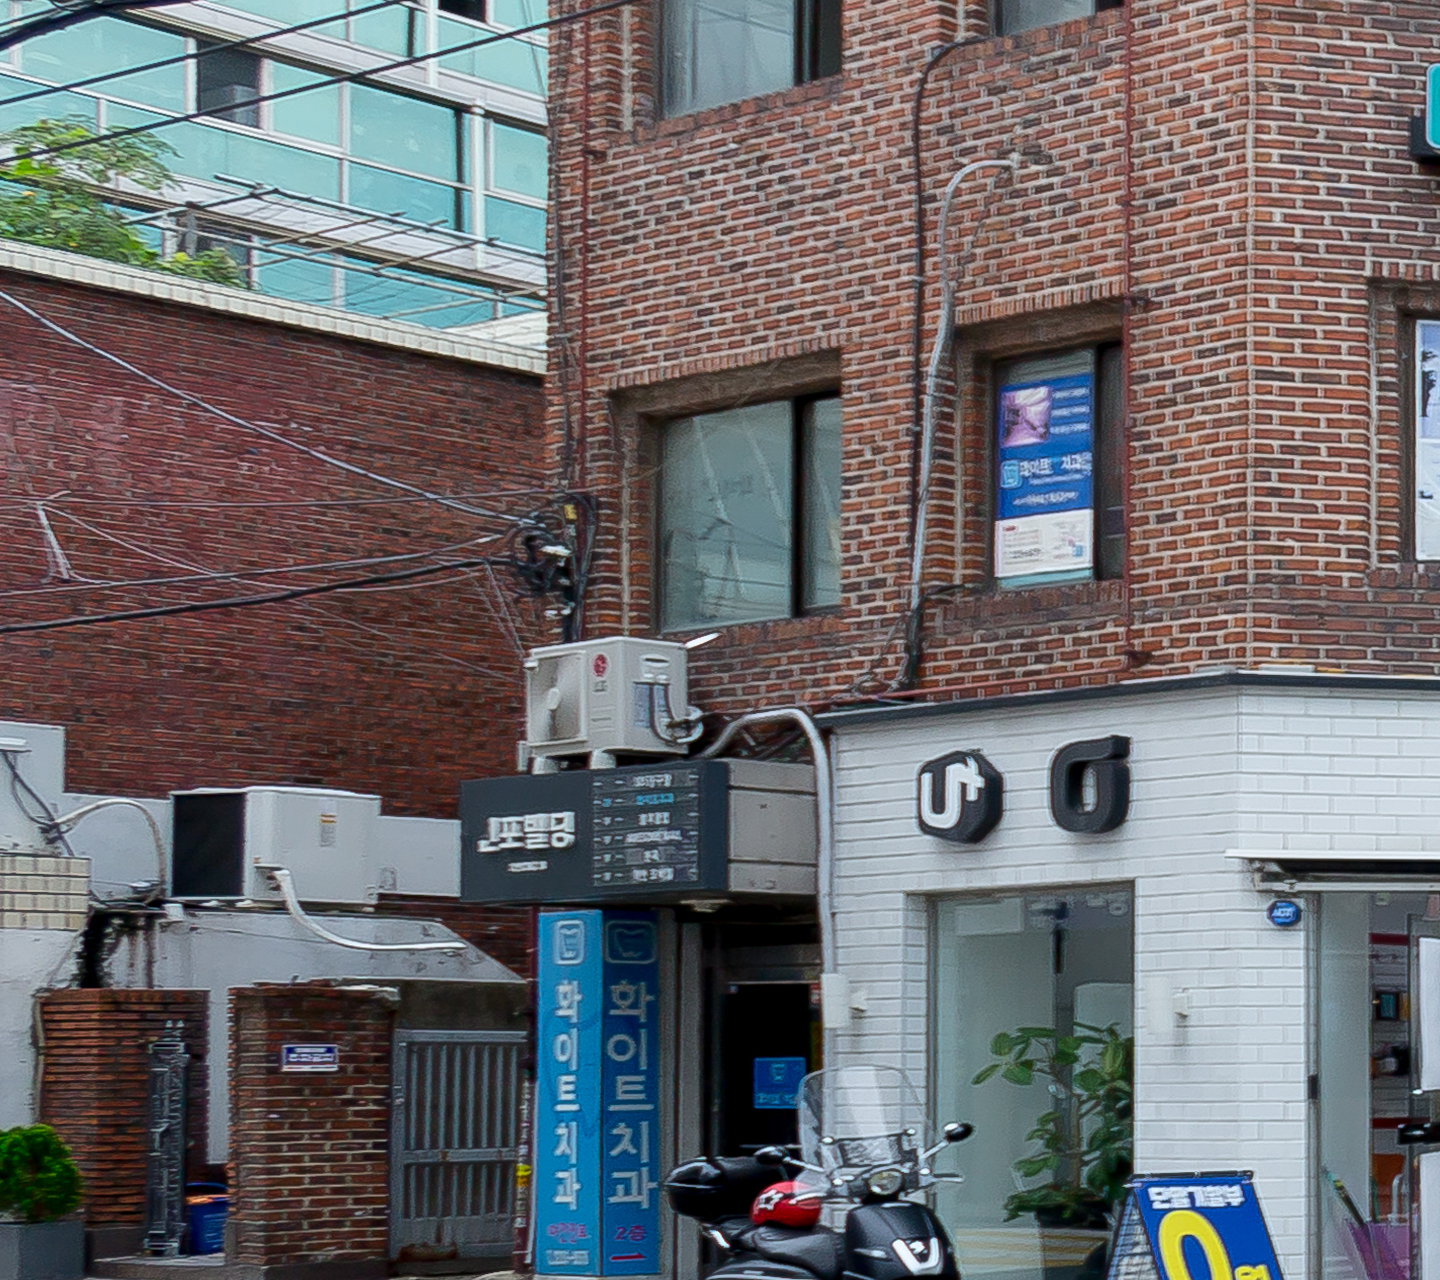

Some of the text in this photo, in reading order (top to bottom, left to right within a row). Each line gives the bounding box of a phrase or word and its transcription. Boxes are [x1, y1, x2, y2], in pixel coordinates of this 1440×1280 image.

[553, 978, 583, 1210] 화이트치과
[607, 979, 658, 1210] 화이트치과
[614, 1225, 647, 1241] 2층
